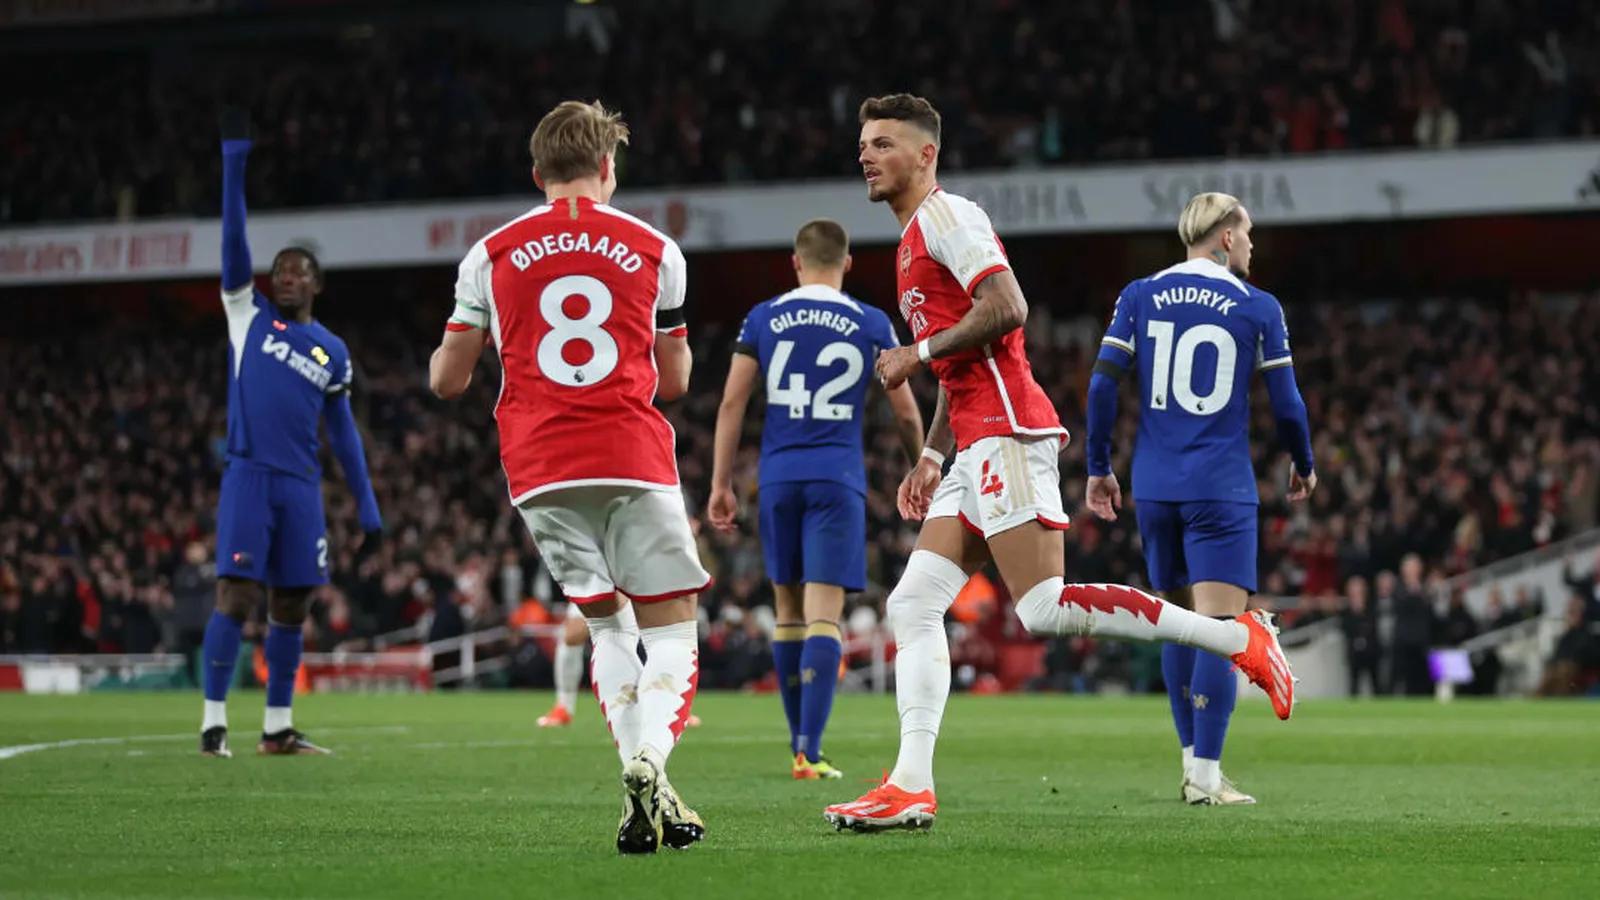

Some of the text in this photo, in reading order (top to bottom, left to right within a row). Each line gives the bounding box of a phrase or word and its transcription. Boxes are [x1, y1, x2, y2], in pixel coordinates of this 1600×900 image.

[510, 232, 643, 273] ØDEGAARD
[1152, 287, 1238, 316] MUDRYK
[536, 274, 619, 387] 8
[769, 309, 860, 337] GILCHRIST
[766, 340, 865, 420] 42
[1147, 319, 1238, 416] 10
[980, 459, 1004, 498] 4
